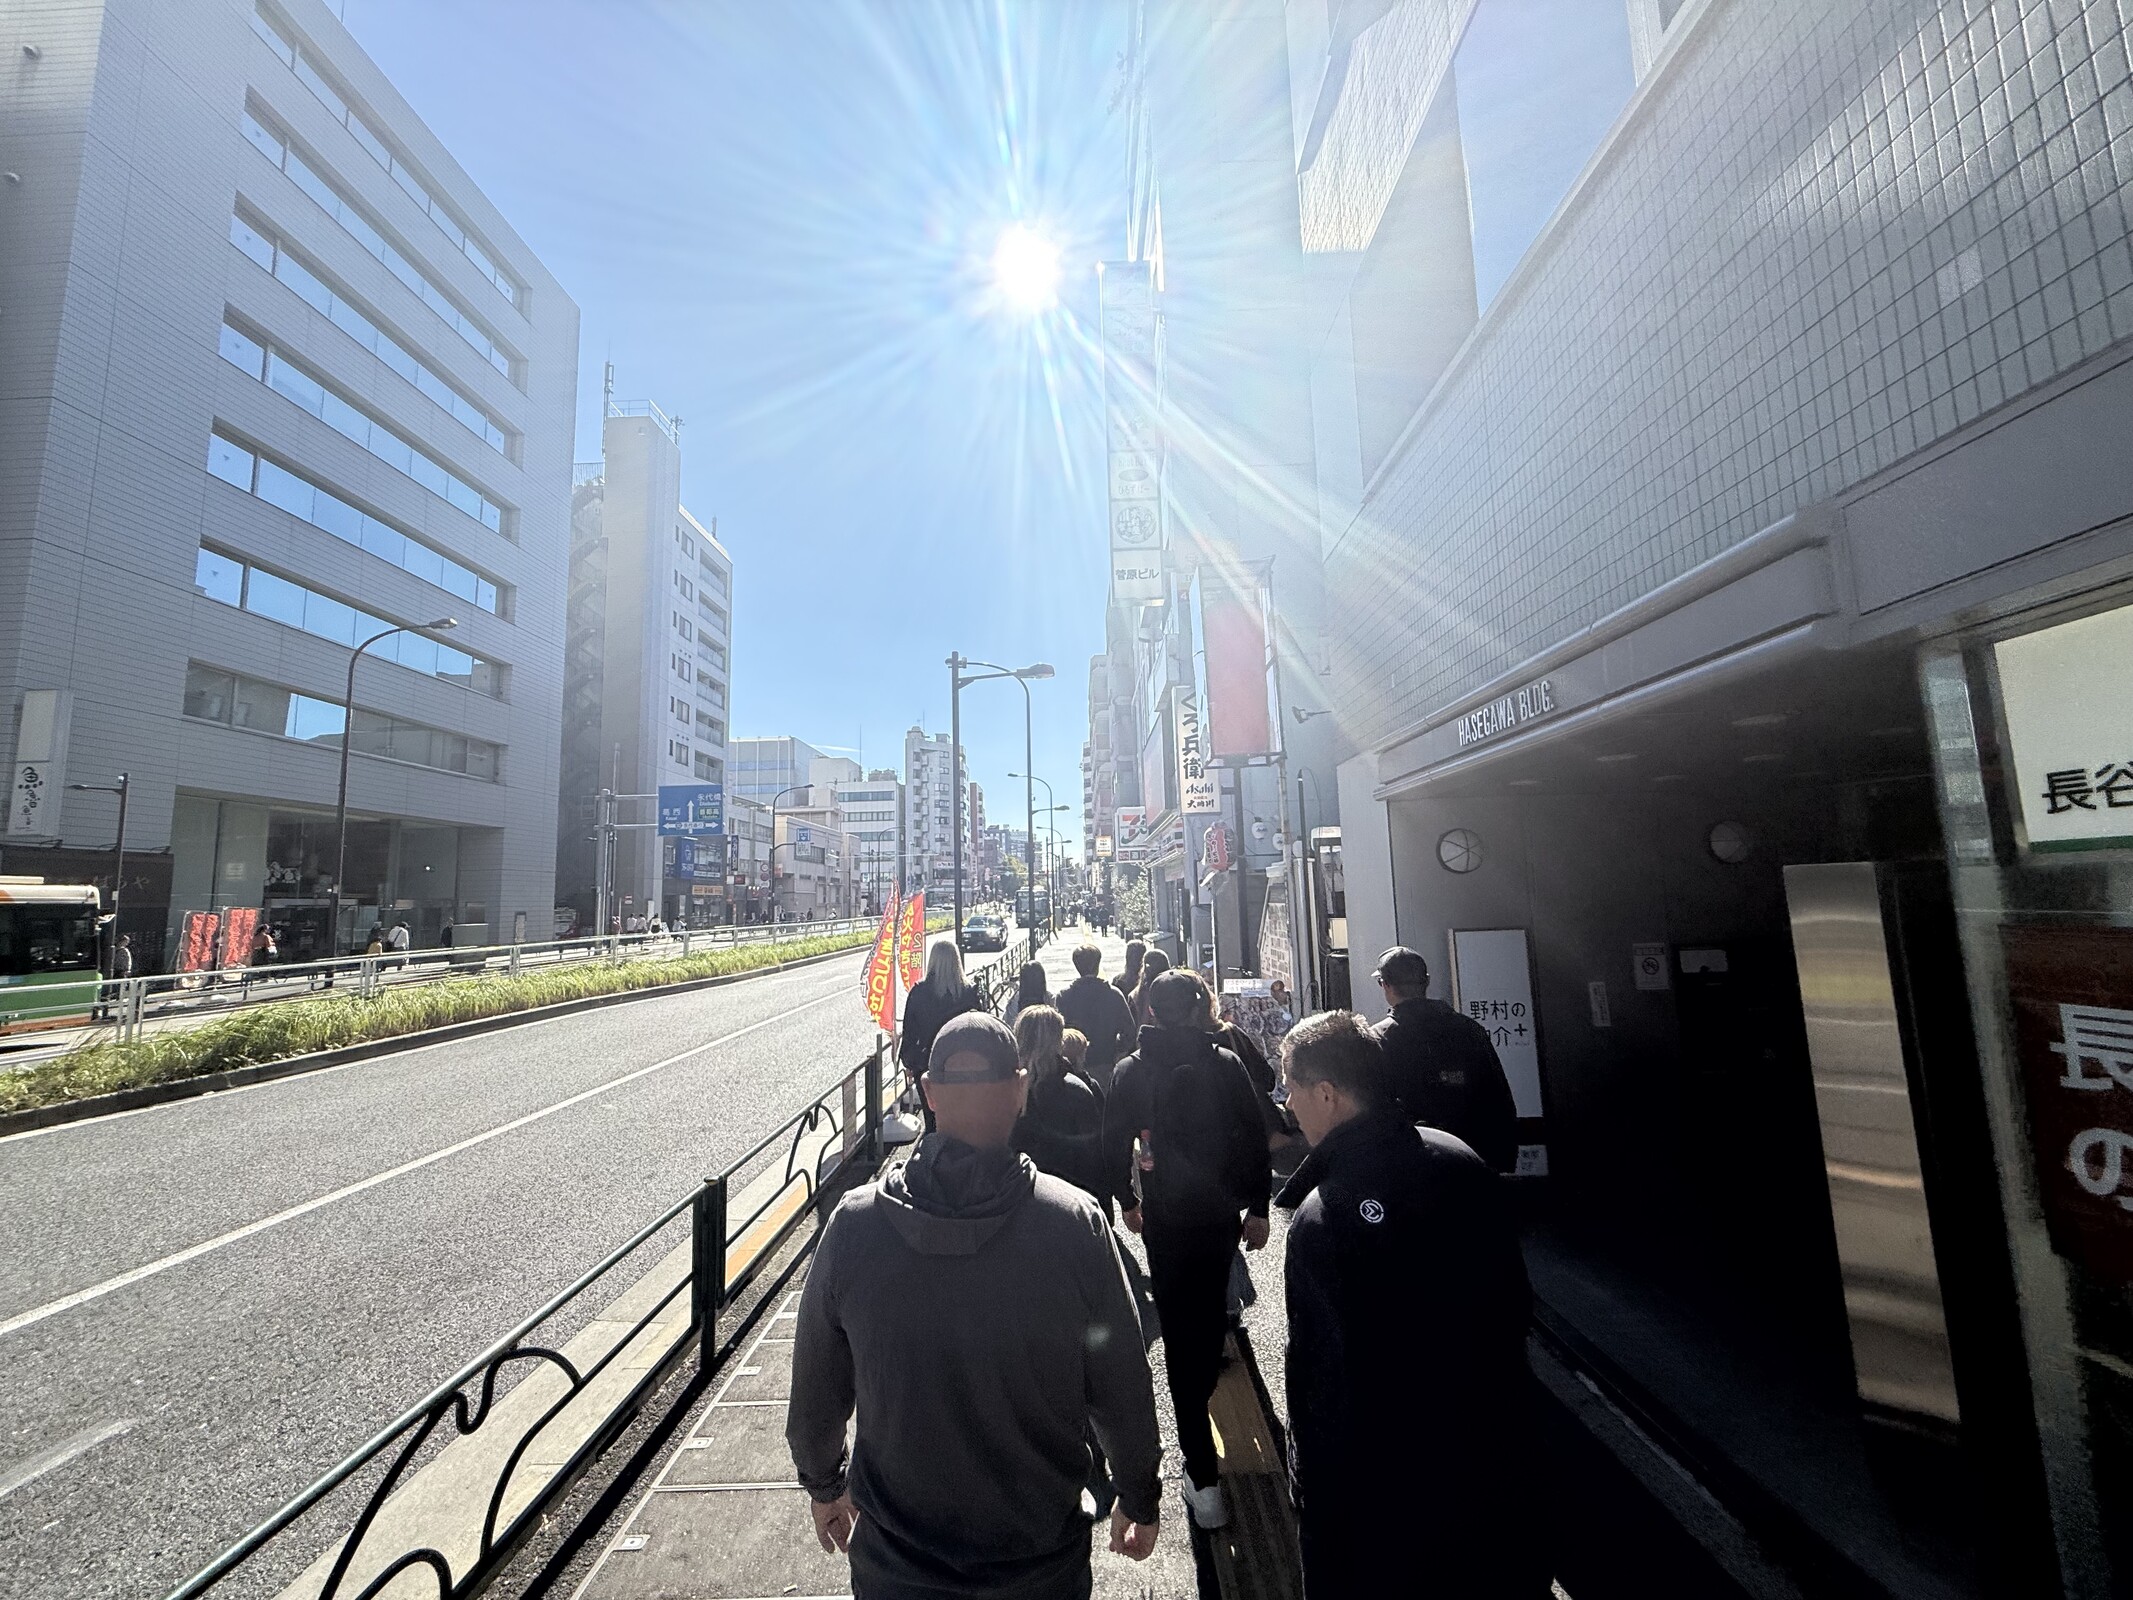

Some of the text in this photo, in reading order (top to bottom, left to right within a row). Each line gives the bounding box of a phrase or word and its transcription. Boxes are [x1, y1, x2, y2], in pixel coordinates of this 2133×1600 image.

[1115, 567, 1160, 581] 菅原ビル
[1457, 680, 1555, 747] HASEGAWA BLDG.
[1181, 691, 1205, 780] くろ兵衛
[1186, 782, 1214, 795] Asahi
[2042, 760, 2133, 815] 長谷
[1469, 999, 1526, 1021] 野村の
